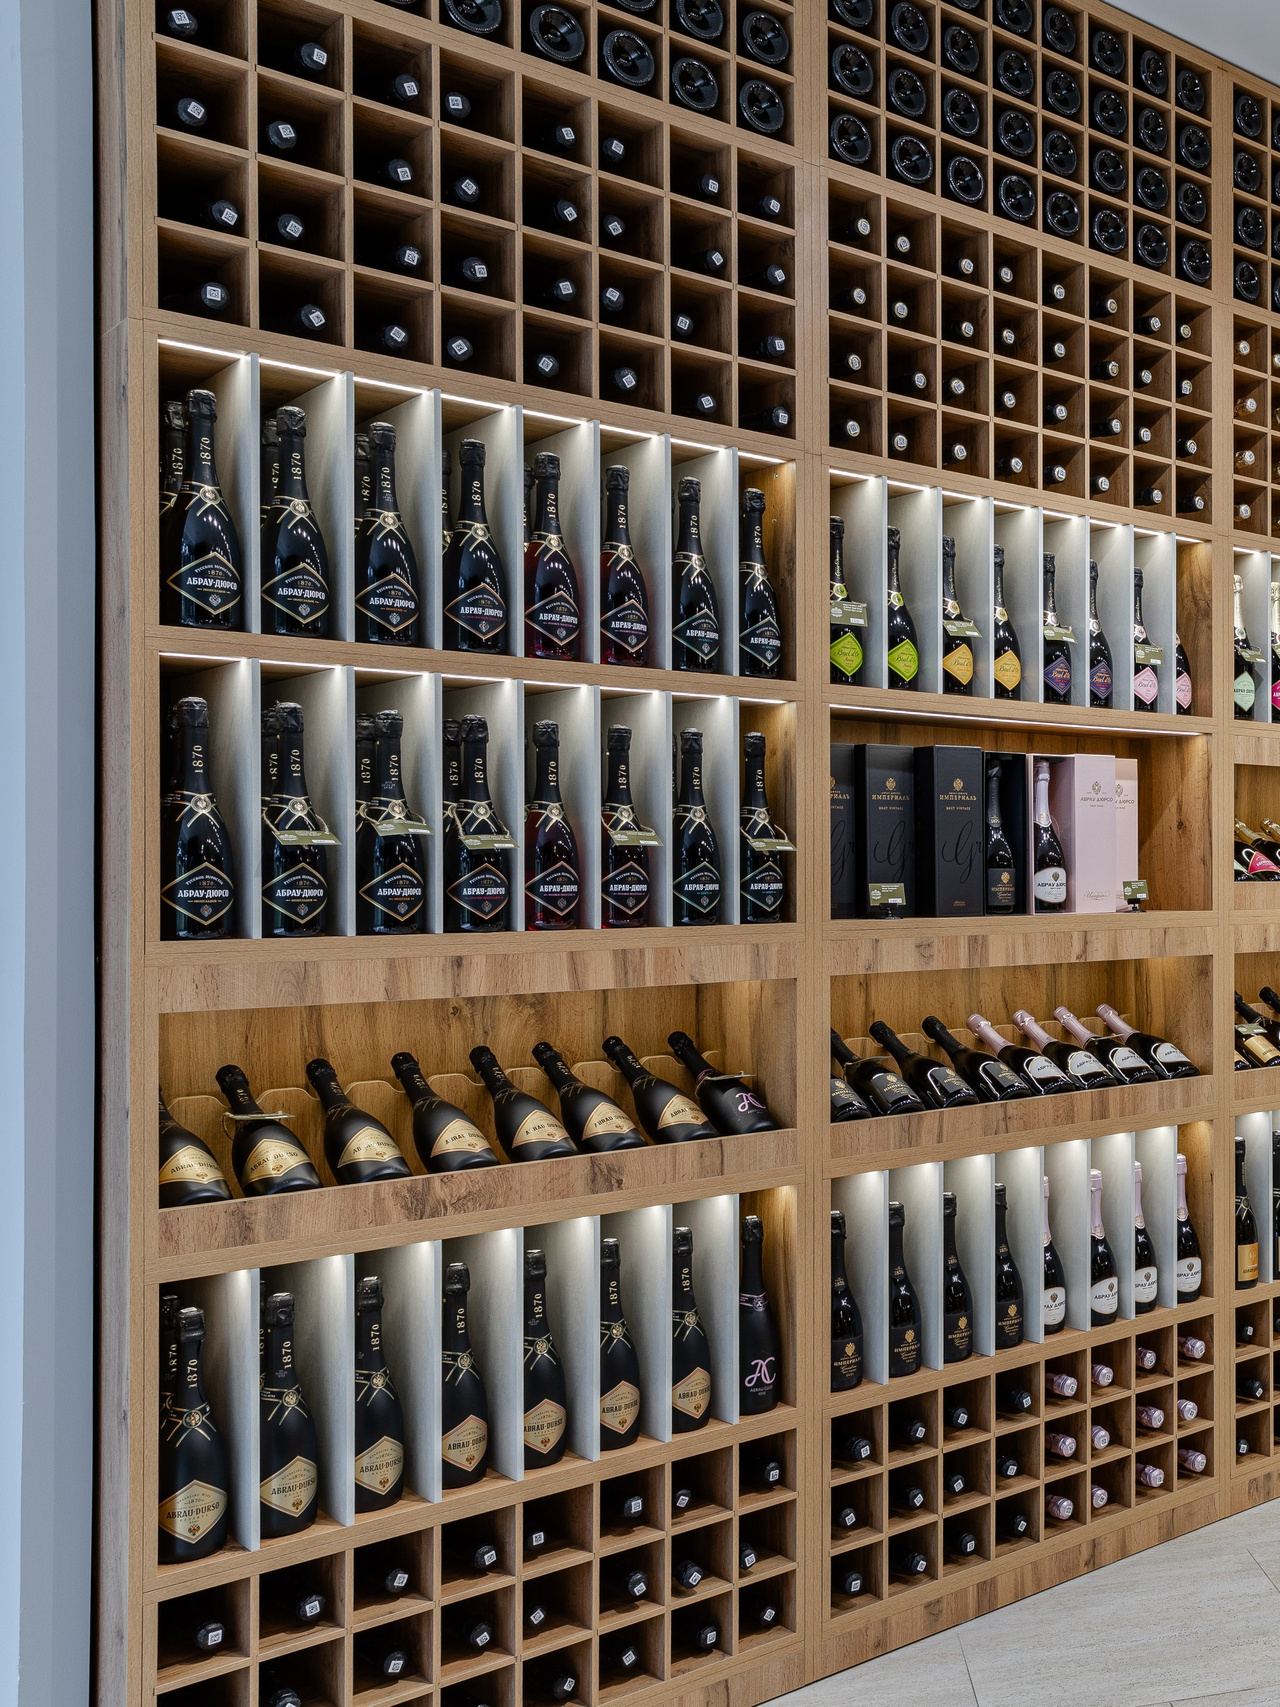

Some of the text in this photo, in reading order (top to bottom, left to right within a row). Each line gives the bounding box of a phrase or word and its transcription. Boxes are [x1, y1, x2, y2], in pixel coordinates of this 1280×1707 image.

[171, 447, 183, 476] 1870
[200, 437, 211, 466] 1870
[291, 452, 302, 481] 1870
[381, 467, 391, 494] 1870
[472, 480, 482, 507] 1870
[547, 493, 556, 519] 1870
[618, 504, 627, 529] 1870
[690, 515, 698, 539] 1870
[754, 525, 762, 549] 1870
[192, 745, 203, 774] 1870
[290, 749, 301, 777] 1870
[361, 758, 371, 785] 1870
[389, 754, 399, 782] 1870
[474, 757, 483, 784] 1870
[449, 761, 458, 787] 1870
[548, 761, 557, 787] 1870
[618, 764, 627, 790] 1870
[692, 766, 701, 790] 1870
[755, 769, 763, 792] 1870
[682, 1267, 690, 1292] 1870
[533, 1293, 543, 1319] 1870
[456, 1307, 465, 1334] 1870
[371, 1323, 380, 1351] 1870
[282, 1341, 291, 1369] 1870
[187, 1358, 198, 1388] 1870
[165, 1501, 221, 1519] ABRAU·DURSO
